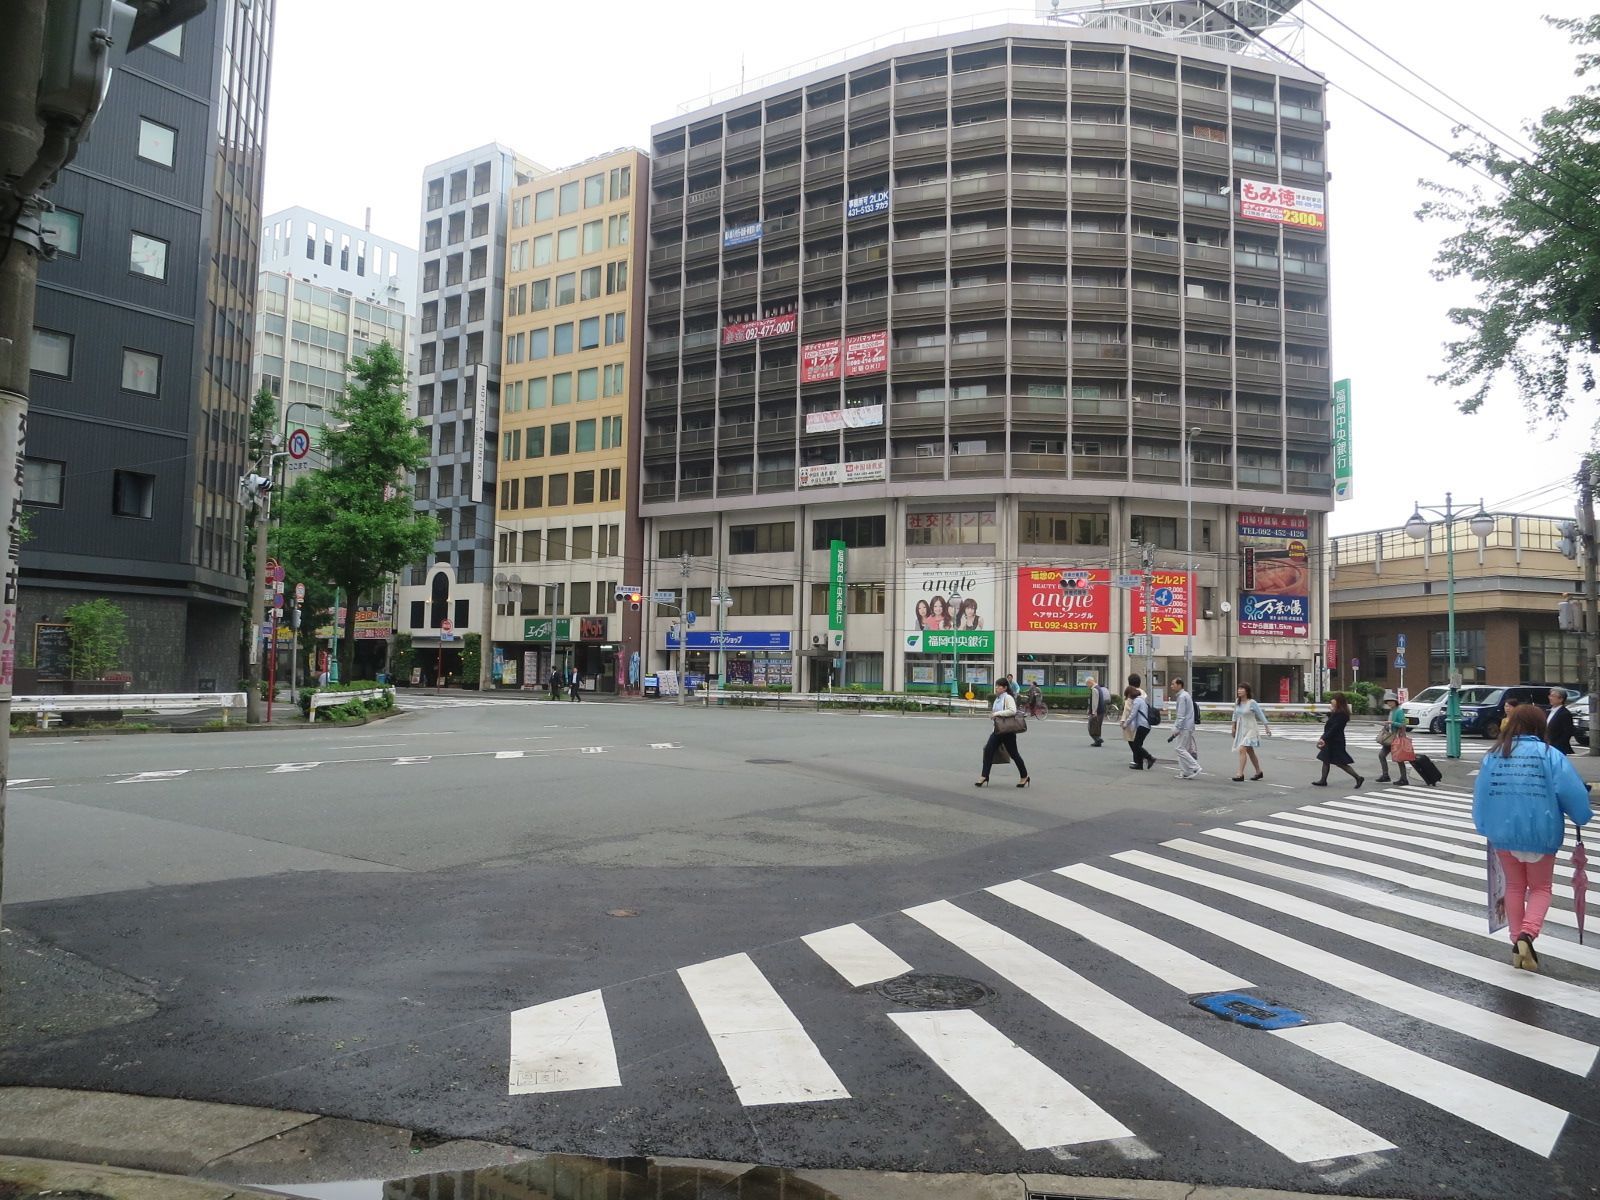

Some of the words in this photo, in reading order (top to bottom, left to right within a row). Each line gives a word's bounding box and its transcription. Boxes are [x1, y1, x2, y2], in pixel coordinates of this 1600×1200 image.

[870, 191, 889, 203] 2LDK
[1243, 182, 1296, 207] もみ徳
[1336, 388, 1347, 469] 福岡中央銀行
[836, 549, 844, 624] 福岡中央銀行
[1067, 611, 1094, 619] アングル
[1254, 598, 1302, 616] 万葉の湯
[928, 635, 989, 648] 福岡中央銀行
